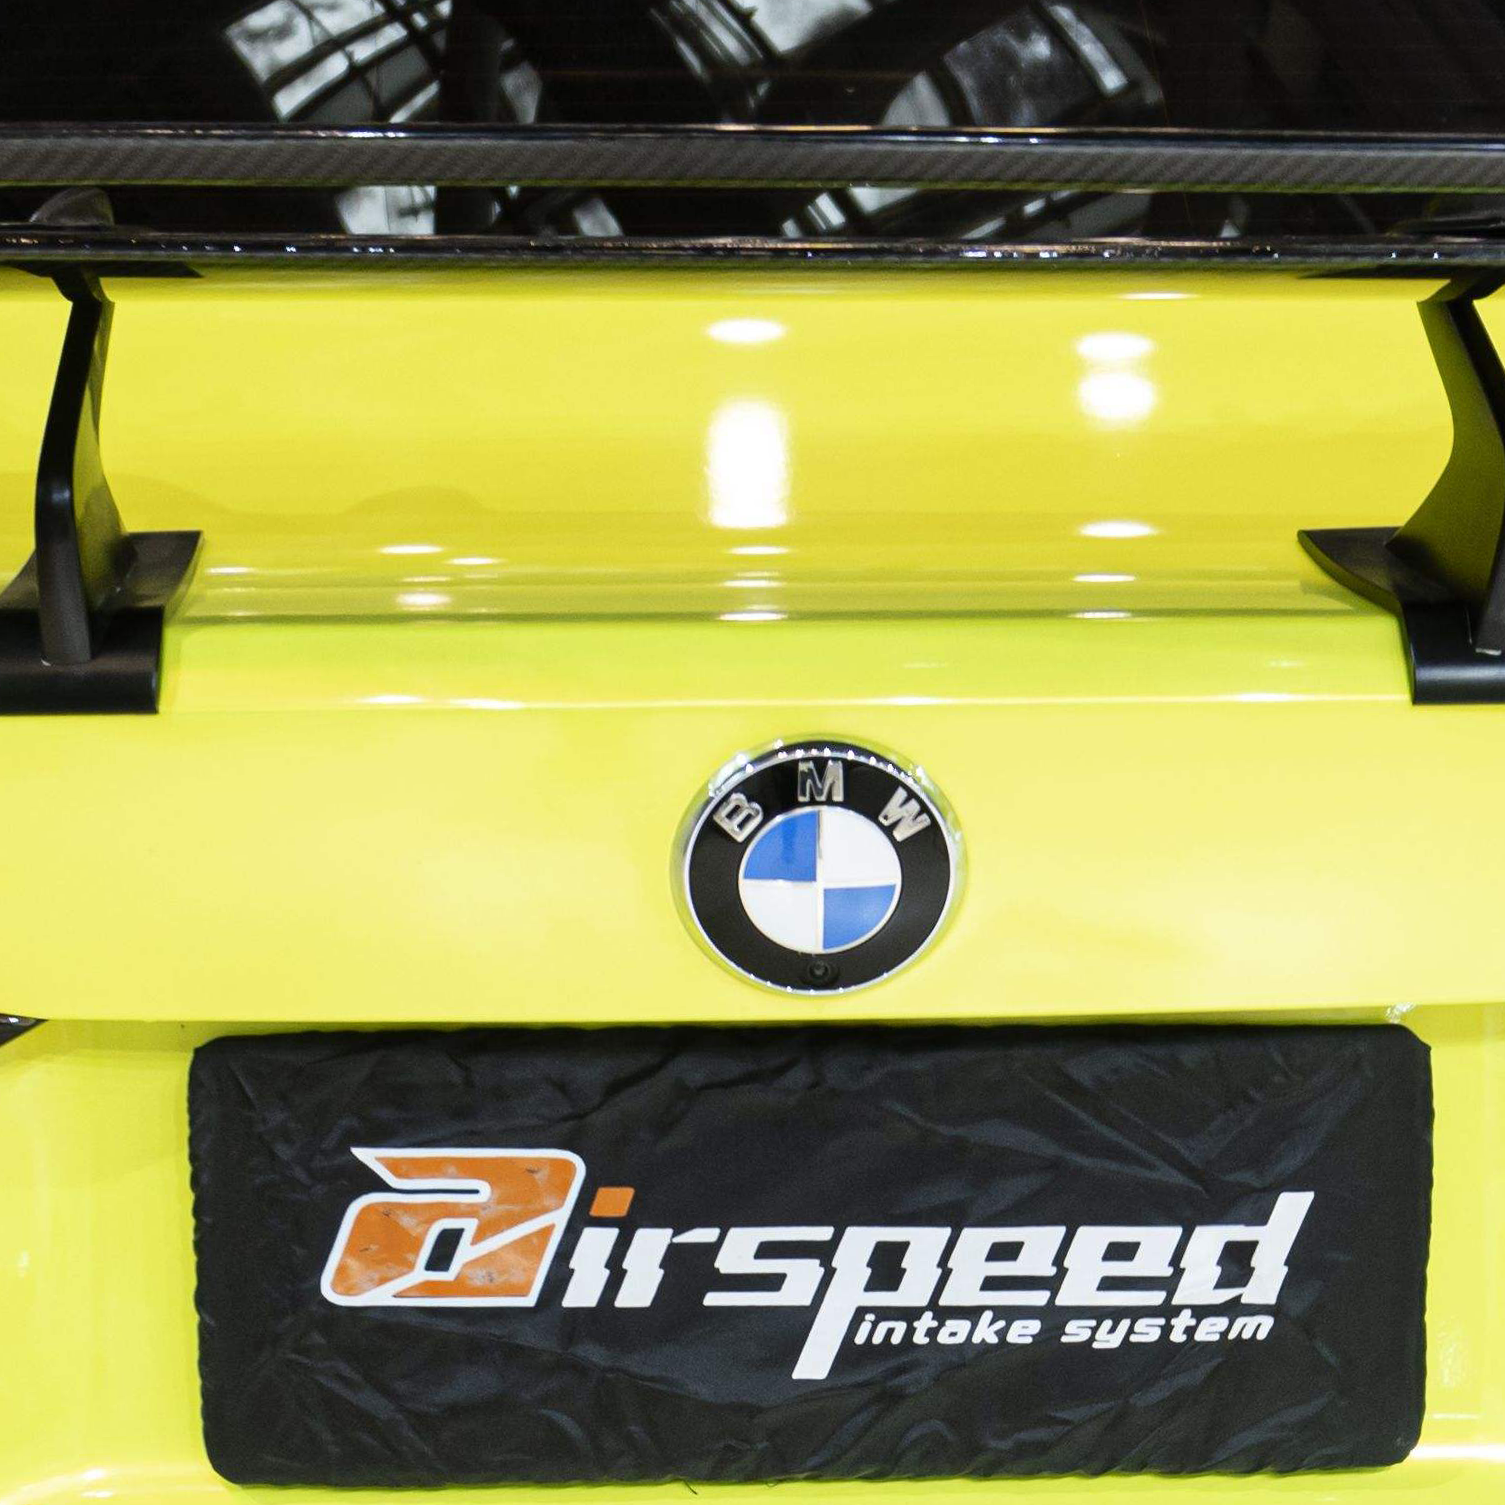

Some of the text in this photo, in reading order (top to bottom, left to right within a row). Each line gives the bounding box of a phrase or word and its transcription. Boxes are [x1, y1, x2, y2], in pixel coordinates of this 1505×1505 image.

[712, 760, 932, 844] BMW
[853, 1308, 1275, 1350] intake system
